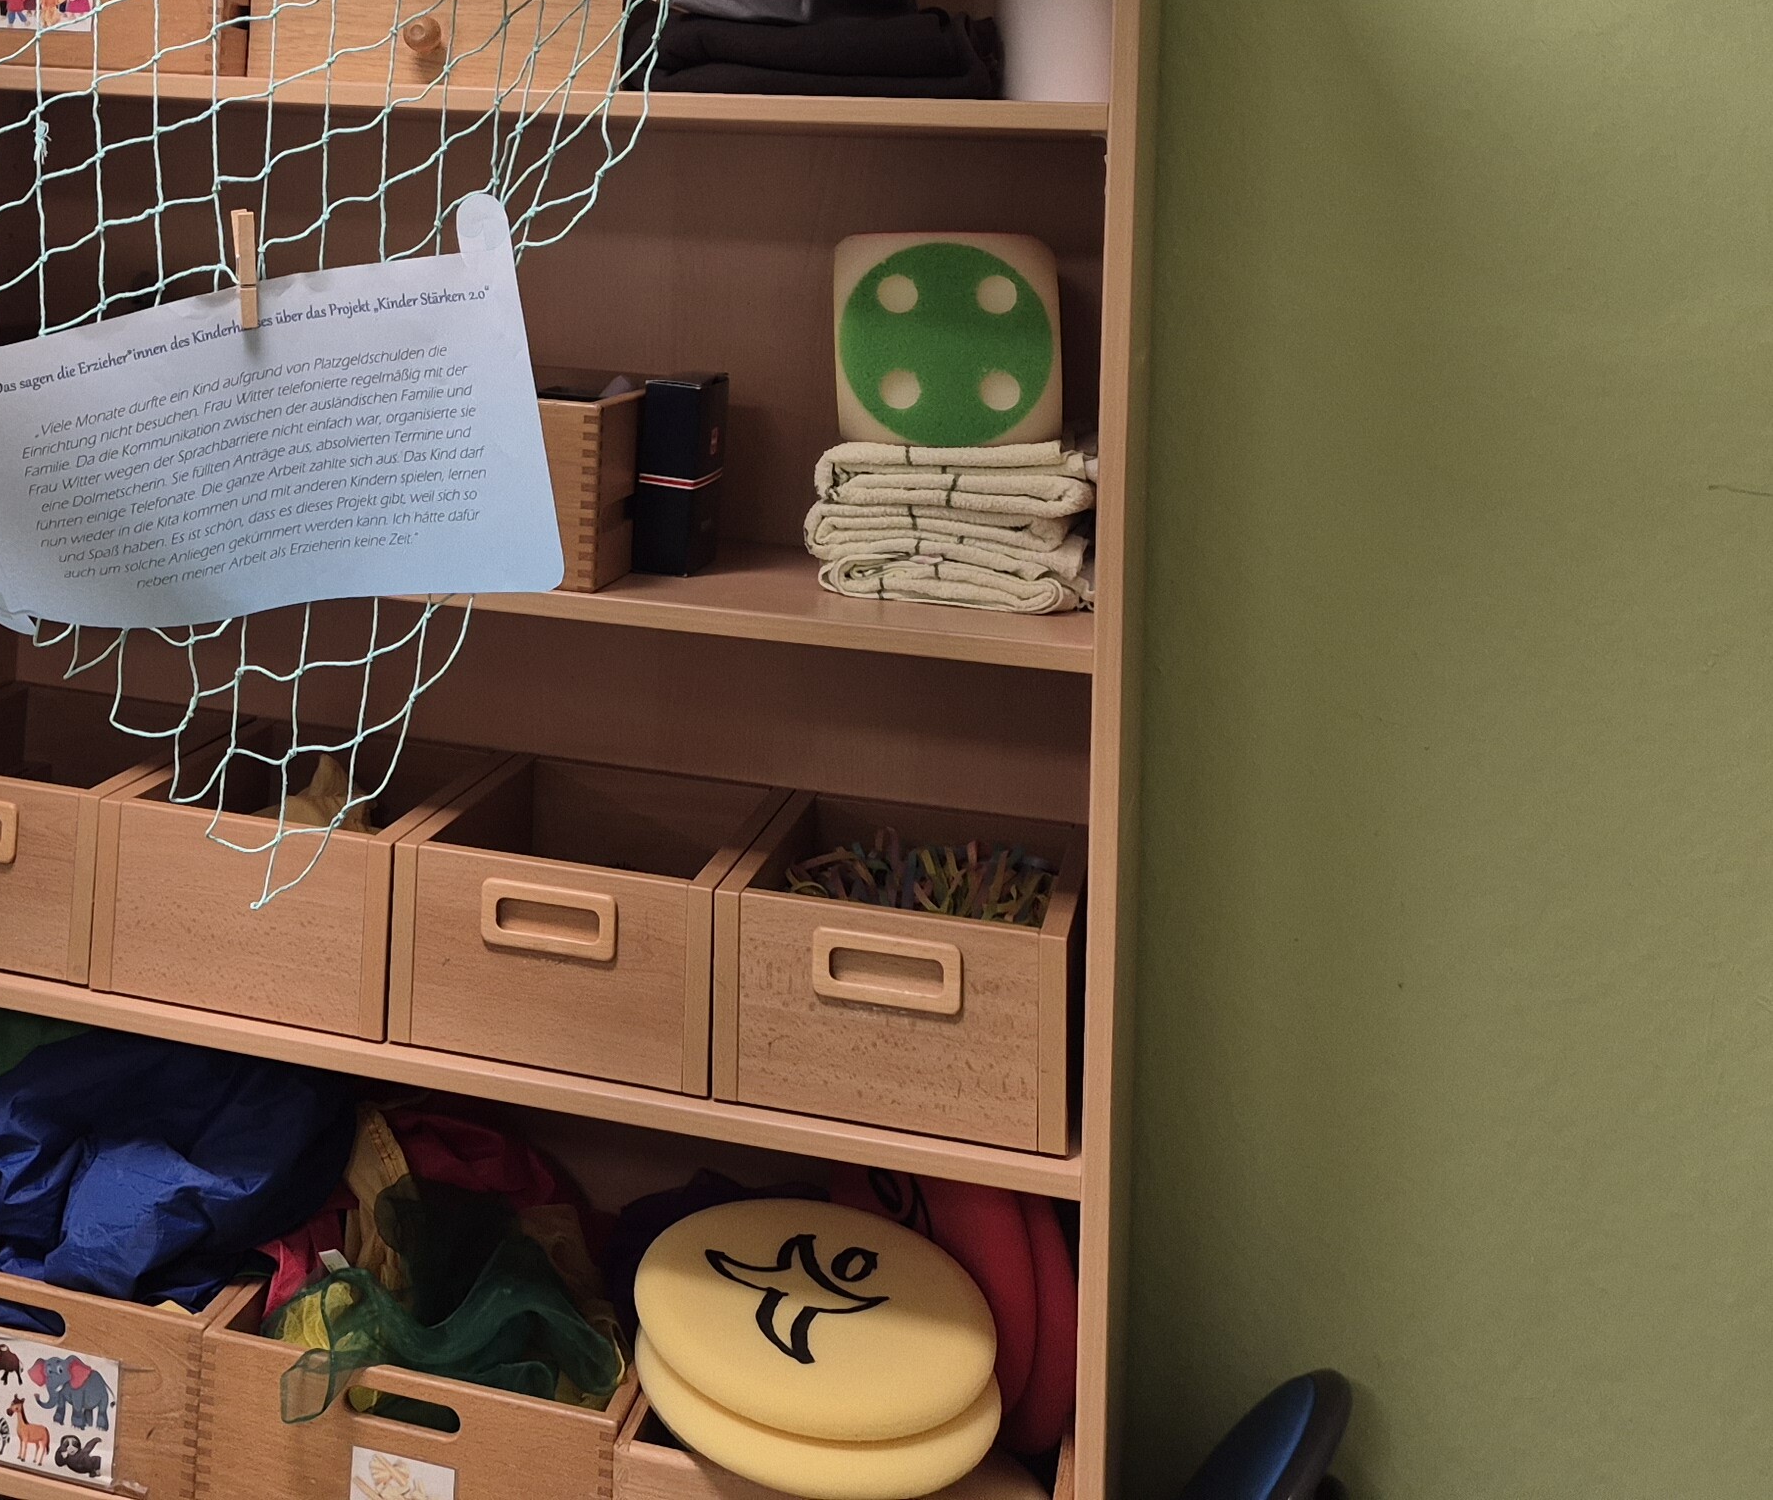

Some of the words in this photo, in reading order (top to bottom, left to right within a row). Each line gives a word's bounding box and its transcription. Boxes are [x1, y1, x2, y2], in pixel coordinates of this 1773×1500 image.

[137, 575, 178, 588] neben
[182, 563, 226, 581] meiner
[229, 551, 266, 570] Arbeit
[270, 547, 286, 559] als
[290, 539, 351, 555] Erzieherin
[354, 537, 386, 547] keine
